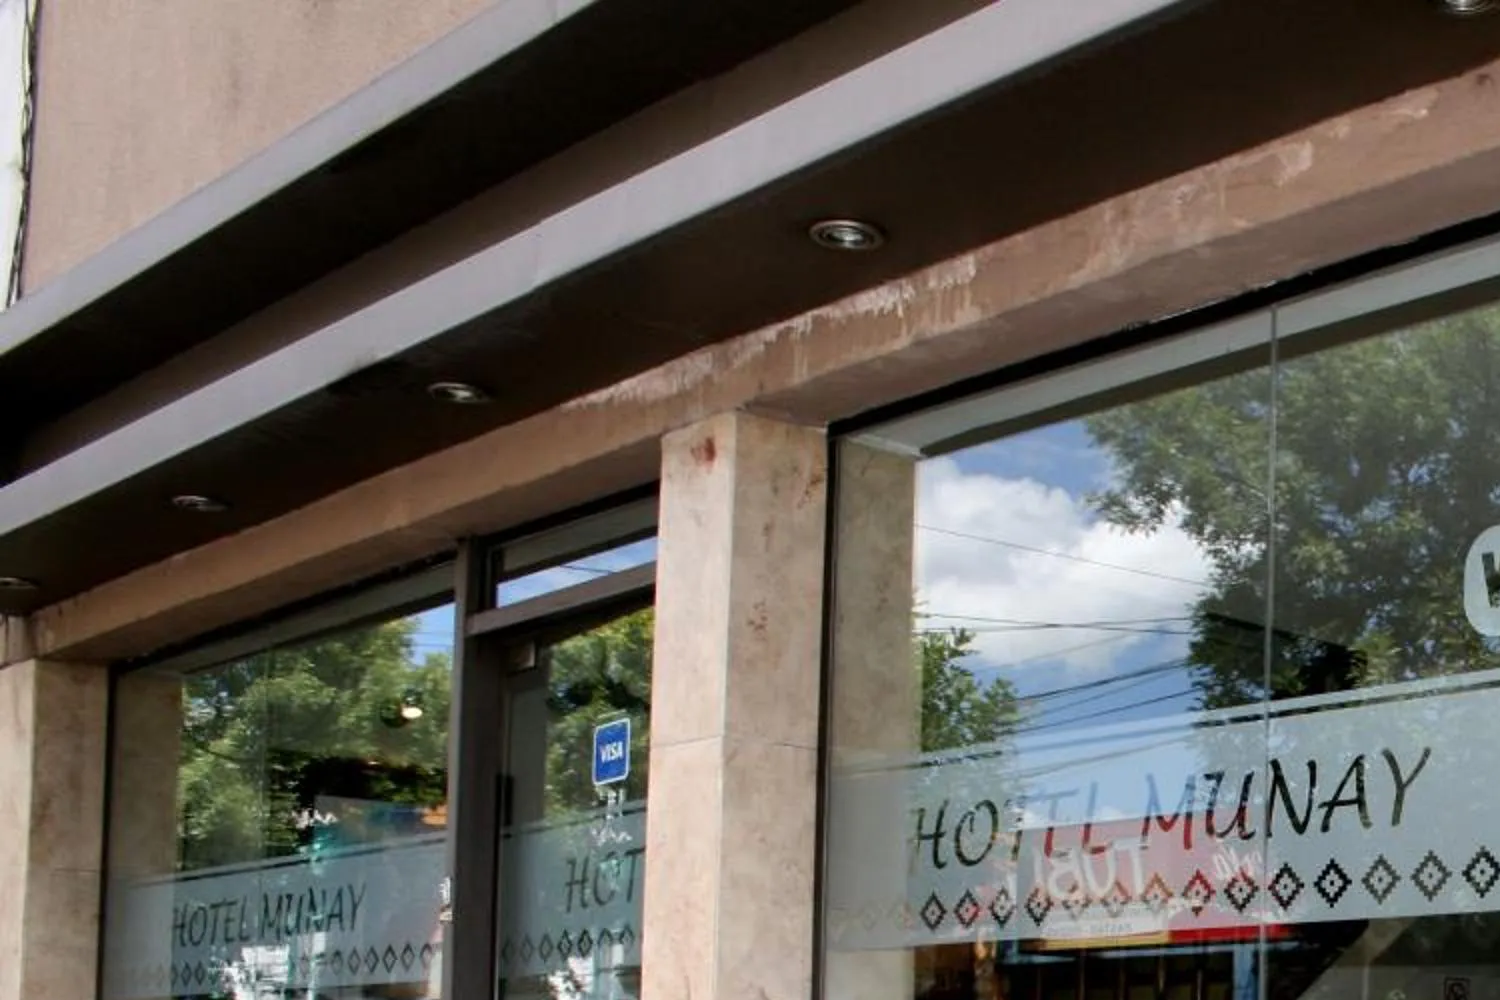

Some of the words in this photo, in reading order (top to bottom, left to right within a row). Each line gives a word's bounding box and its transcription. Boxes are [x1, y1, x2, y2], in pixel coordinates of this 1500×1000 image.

[600, 740, 623, 763] VISA
[1140, 746, 1432, 850] MUNAY
[173, 895, 250, 948] HOTEL
[260, 882, 366, 941] MUNAY
